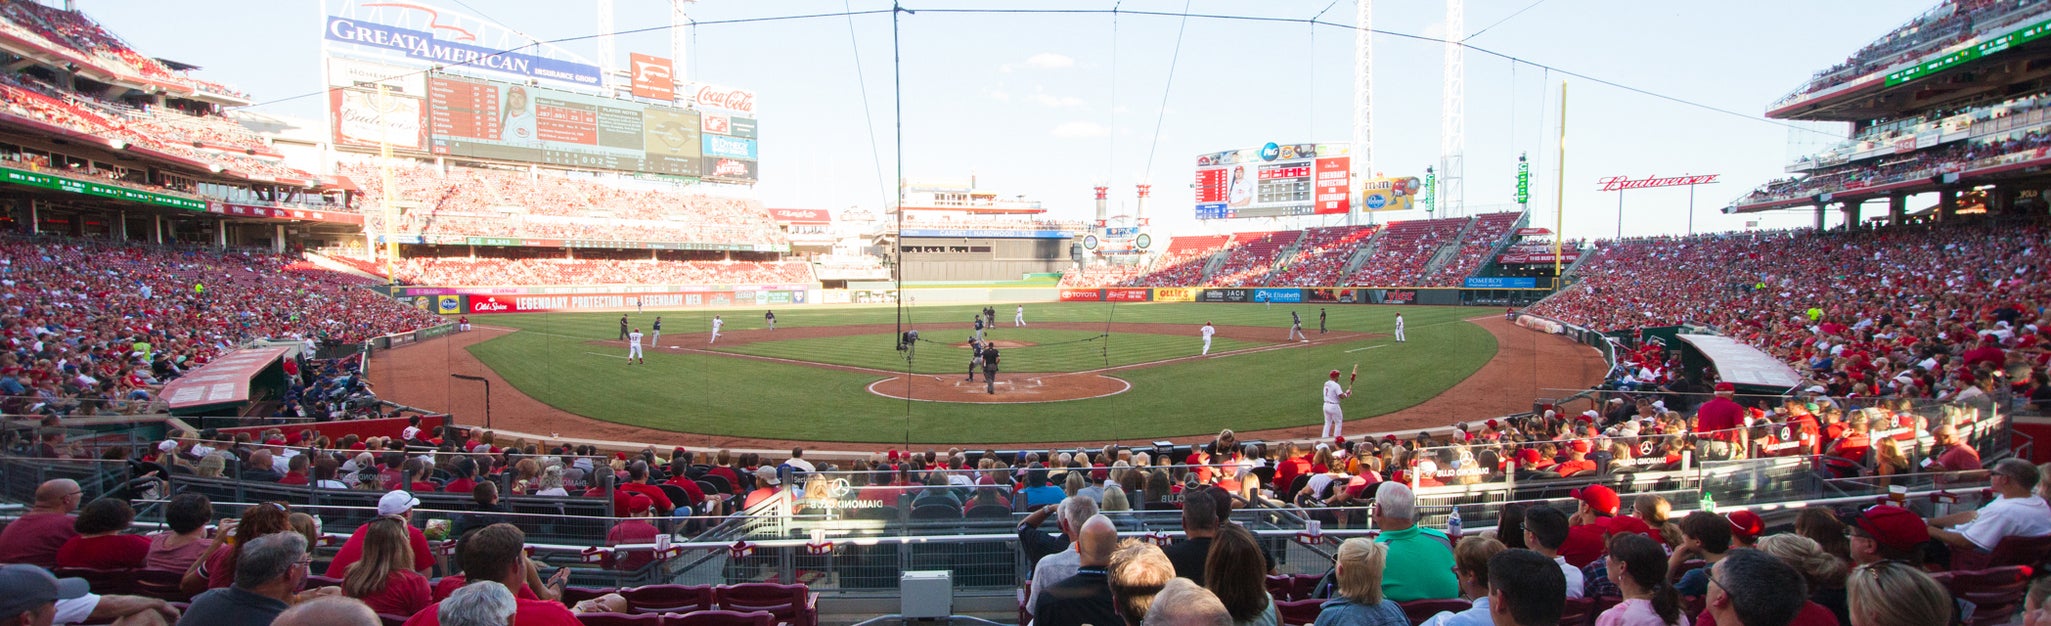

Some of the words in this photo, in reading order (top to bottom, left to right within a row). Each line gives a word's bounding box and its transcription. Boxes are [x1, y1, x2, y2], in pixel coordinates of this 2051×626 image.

[534, 68, 574, 81] INSURANCE
[574, 73, 598, 84] GROUP
[1599, 174, 1719, 192] Budweiser
[475, 302, 491, 311] Old
[489, 303, 507, 311] Spice
[516, 297, 568, 310] LEGENDARY
[571, 296, 623, 309] PROTECTION
[626, 297, 637, 306] FOR
[641, 295, 683, 307] LEGENDARY
[685, 294, 702, 304] MEN
